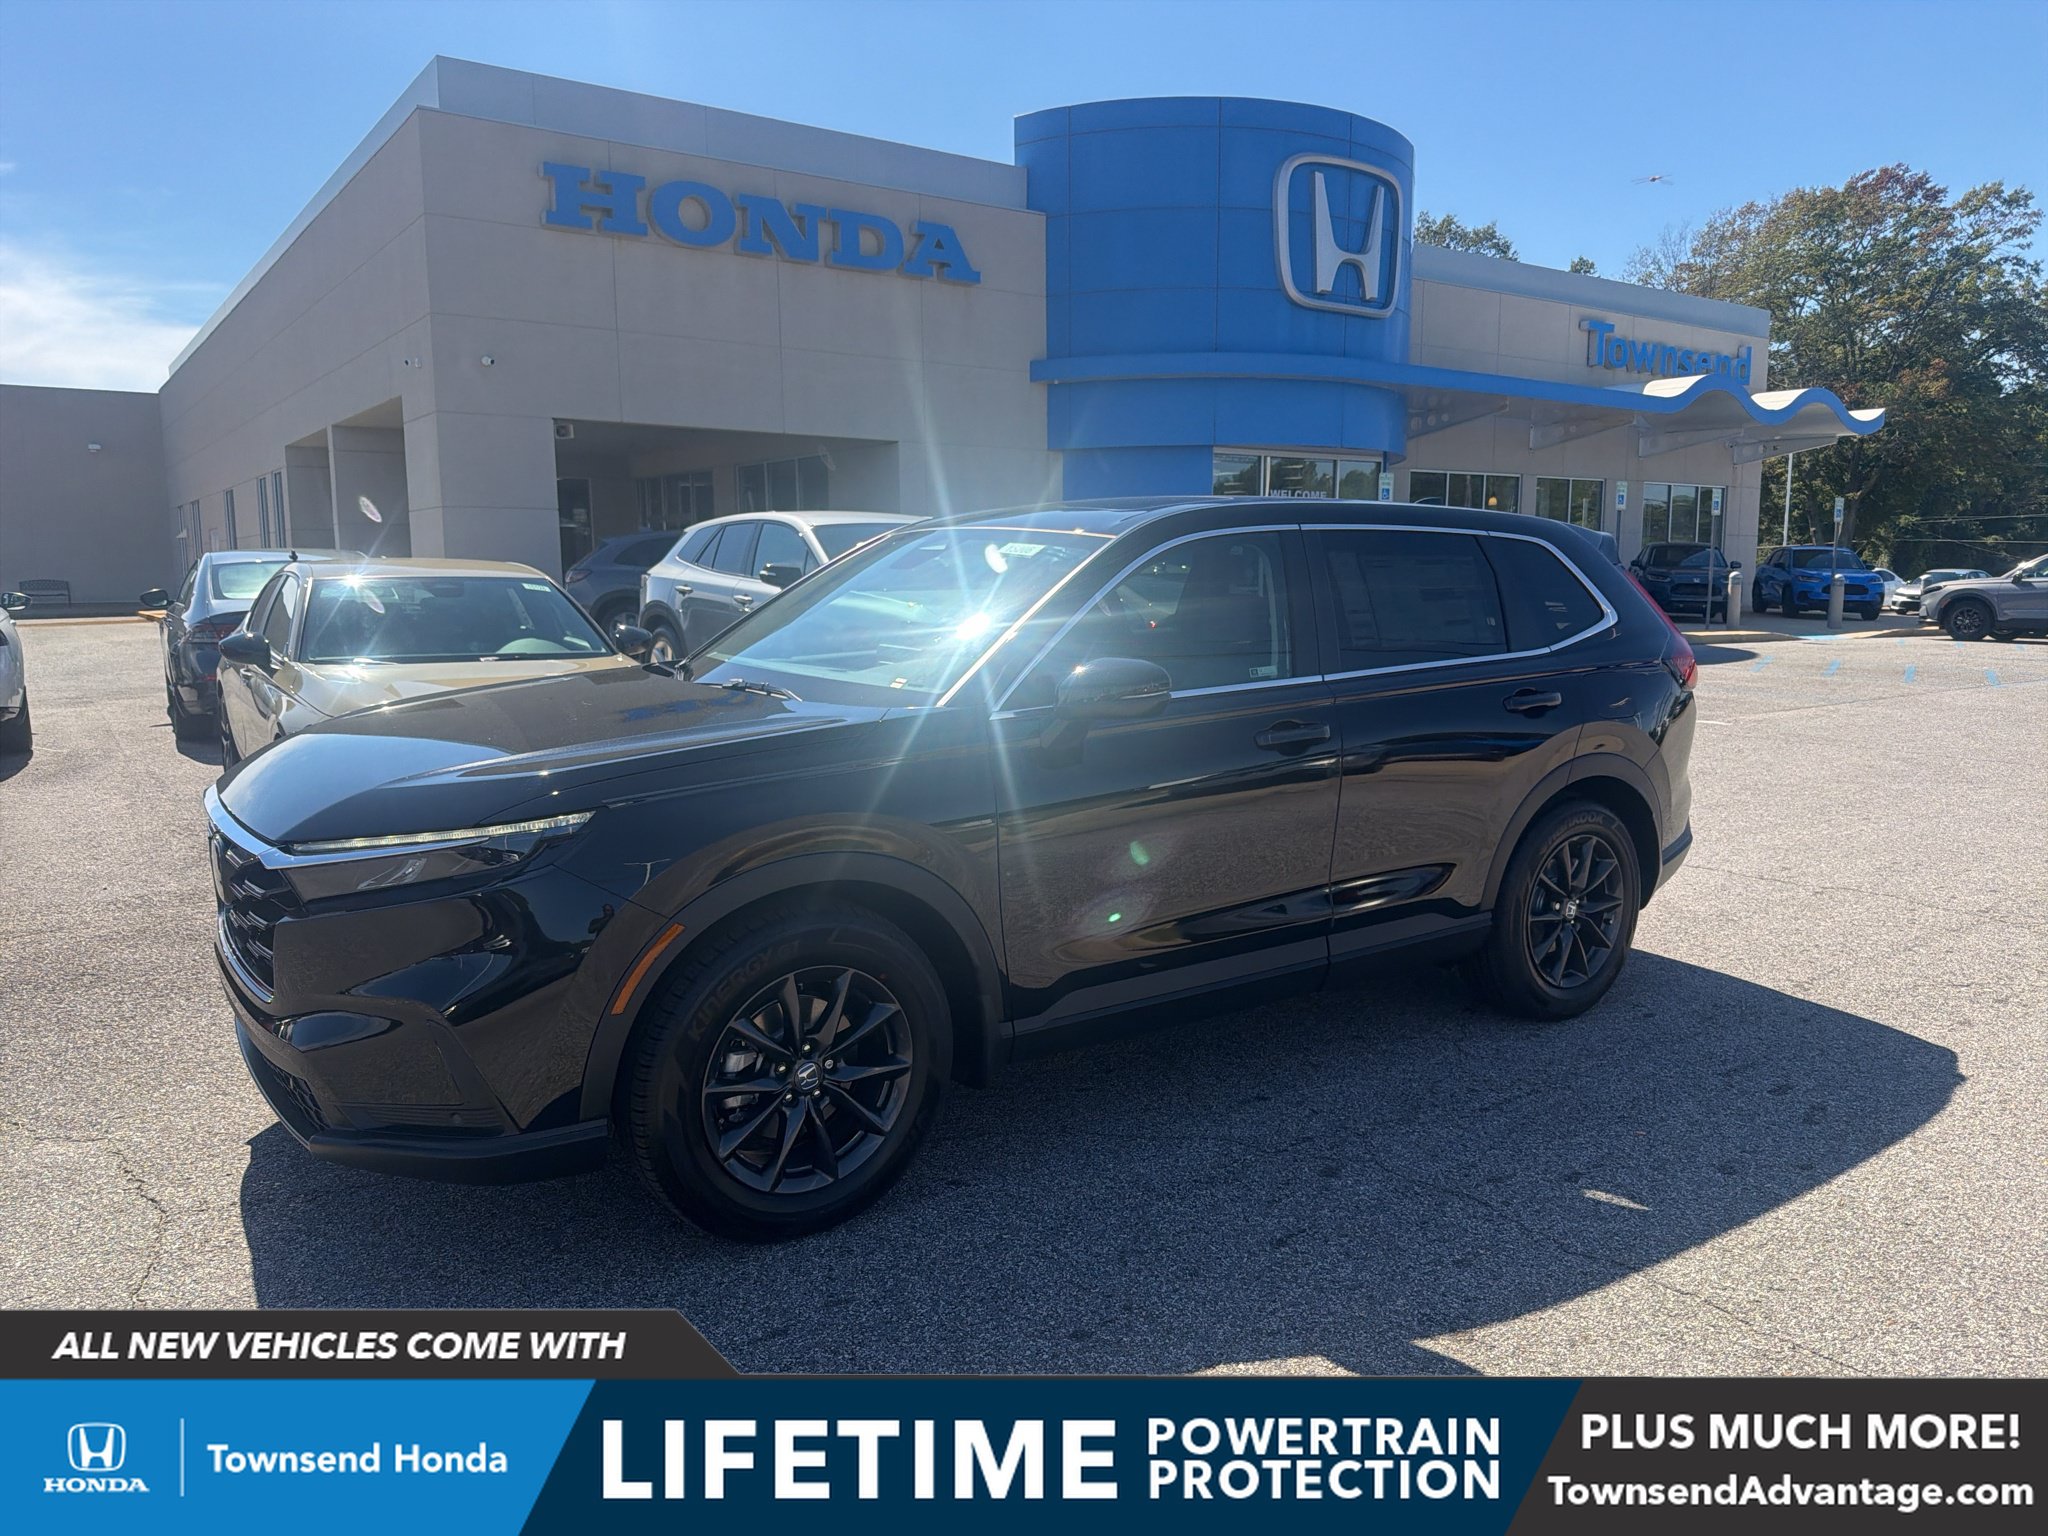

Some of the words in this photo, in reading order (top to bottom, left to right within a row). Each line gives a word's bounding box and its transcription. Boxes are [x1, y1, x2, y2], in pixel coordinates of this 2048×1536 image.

[538, 161, 982, 285] HONDA
[1578, 319, 1753, 386] Townsend
[1269, 489, 1328, 500] WELCOME
